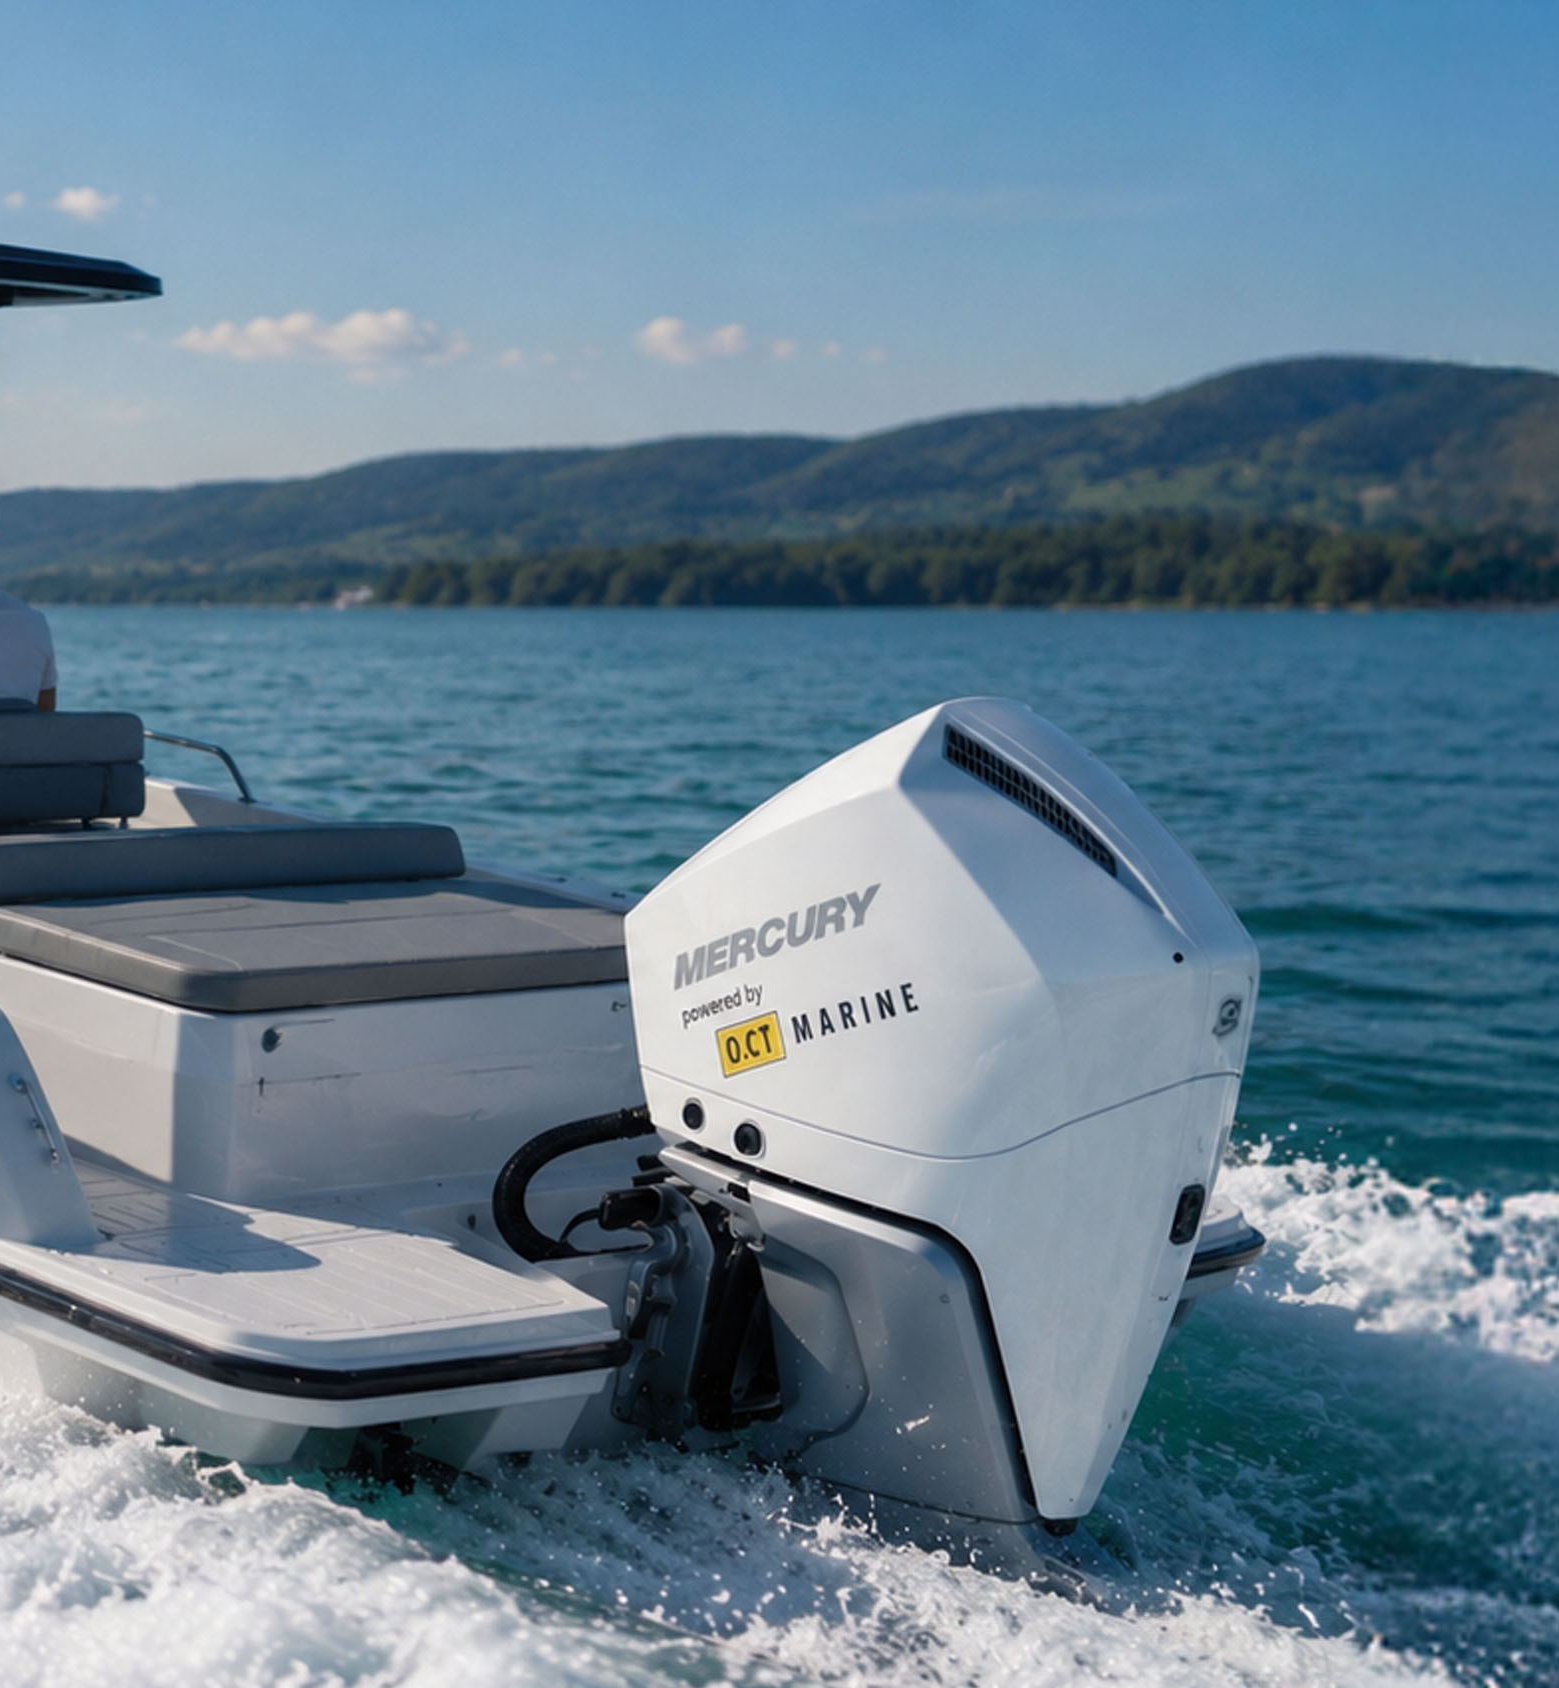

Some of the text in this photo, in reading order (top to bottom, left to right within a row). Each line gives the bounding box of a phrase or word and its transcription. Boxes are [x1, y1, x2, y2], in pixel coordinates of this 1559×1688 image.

[674, 883, 881, 990] MERCURY
[682, 984, 763, 1029] powered by
[791, 982, 920, 1044] MARINE
